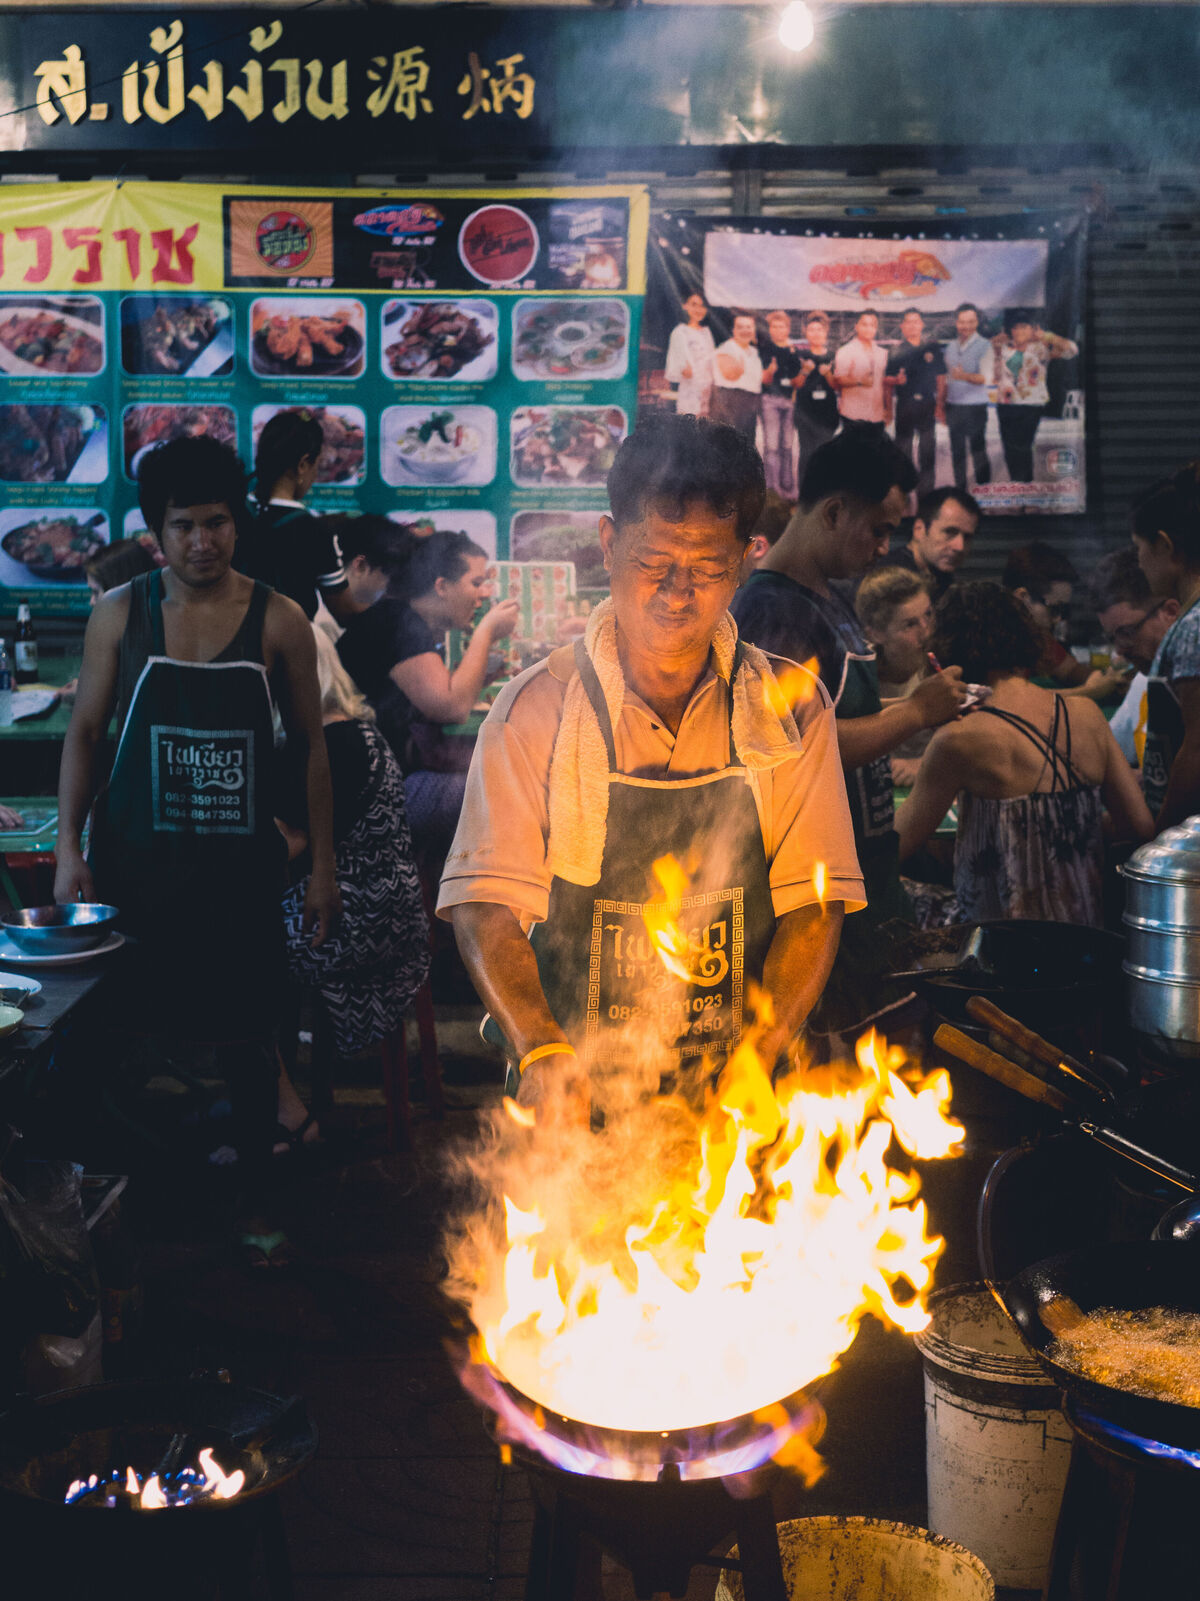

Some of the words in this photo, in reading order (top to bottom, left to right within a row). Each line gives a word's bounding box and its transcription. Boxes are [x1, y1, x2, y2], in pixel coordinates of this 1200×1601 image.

[0, 222, 199, 285] วราช
[160, 741, 242, 767] ไฟเขียว
